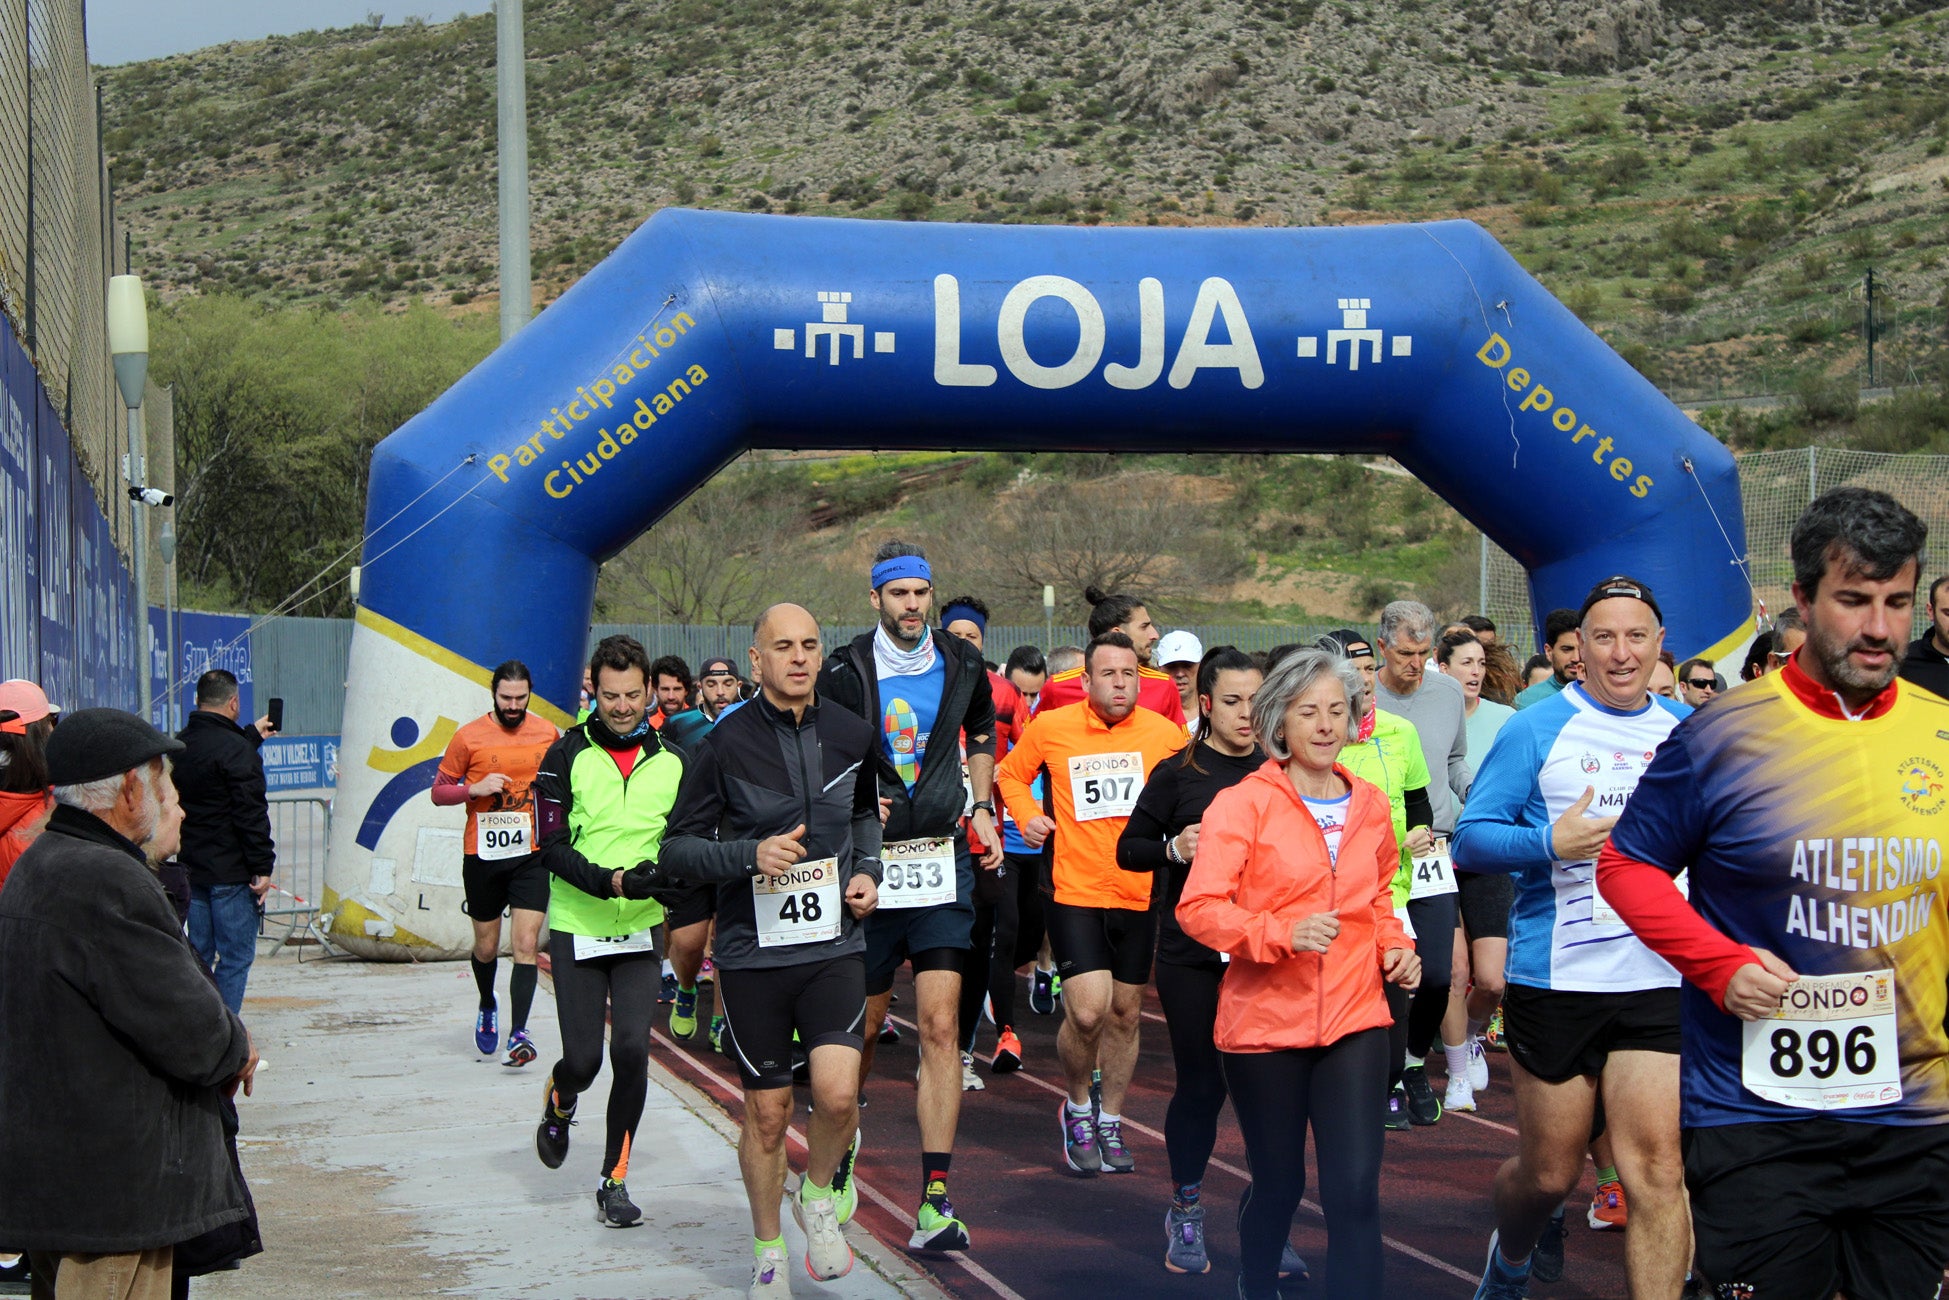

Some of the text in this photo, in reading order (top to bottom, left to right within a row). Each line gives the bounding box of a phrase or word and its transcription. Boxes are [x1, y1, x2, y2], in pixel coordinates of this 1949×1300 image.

[934, 273, 1265, 390] LOJA
[487, 311, 696, 483] Participación
[1476, 332, 1654, 498] Deportes
[543, 364, 709, 499] Ciudadana
[895, 739, 911, 748] 39
[1086, 758, 1129, 771] FONDO
[1897, 756, 1944, 779] ATLETISMO
[1085, 777, 1134, 804] 507
[1900, 796, 1946, 816] ALHENDÍN
[488, 816, 521, 825] FONDO
[486, 829, 524, 848] 904
[890, 841, 938, 854] FONDO
[886, 862, 943, 890] 953
[1417, 860, 1444, 883] 41
[1790, 836, 1942, 892] ATLETISMO
[771, 868, 823, 887] FONDO
[779, 892, 822, 924] 48
[1786, 885, 1936, 949] ALHENDÍN
[1779, 986, 1868, 1010] FONDO
[1770, 1025, 1877, 1079] 896
